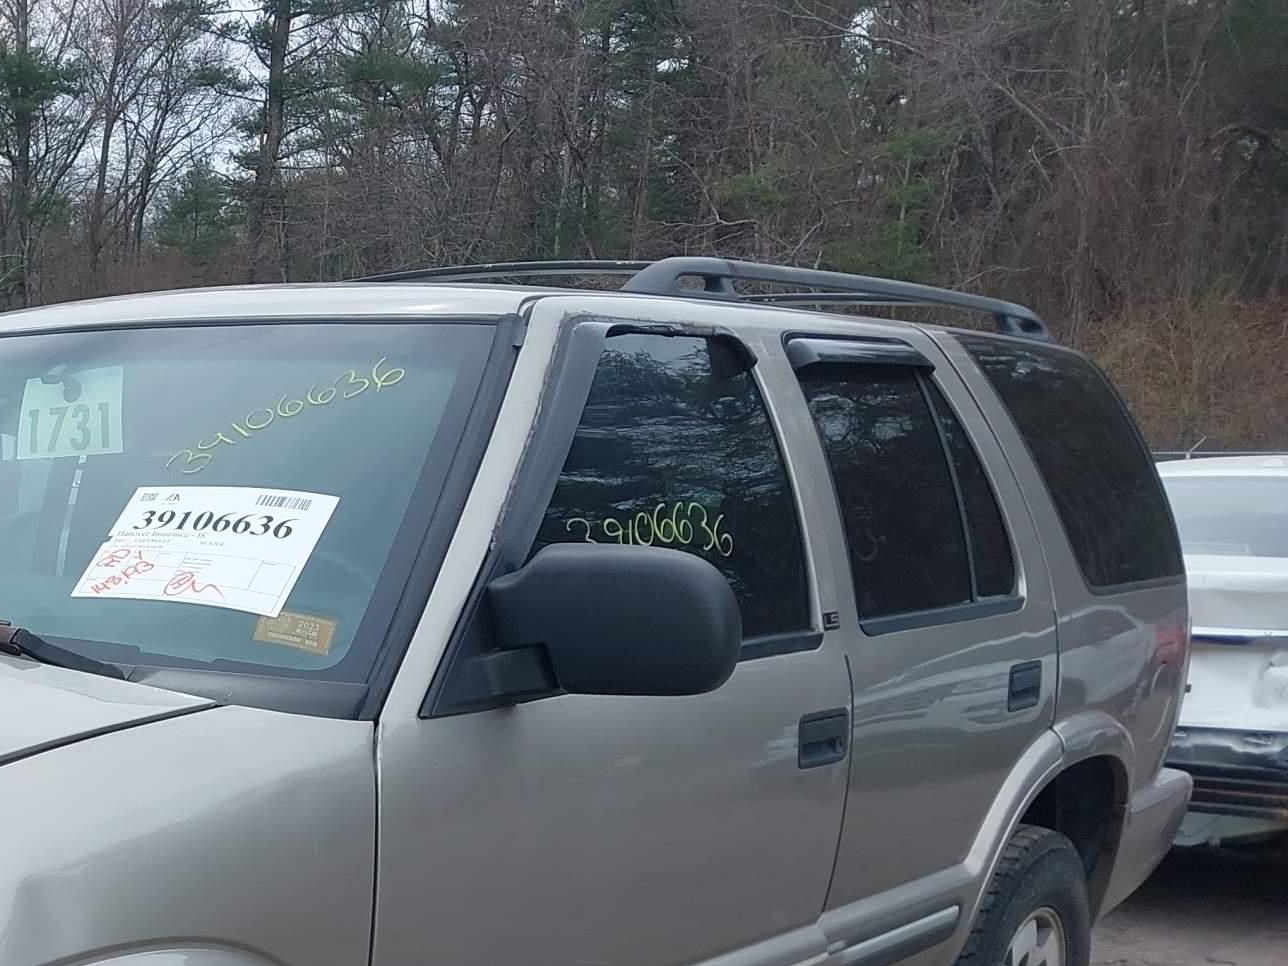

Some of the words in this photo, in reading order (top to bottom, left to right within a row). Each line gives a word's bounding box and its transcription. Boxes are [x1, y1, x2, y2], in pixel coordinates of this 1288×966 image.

[28, 402, 111, 454] 1731
[165, 357, 405, 474] 39106636
[132, 510, 297, 539] 39106636
[151, 530, 190, 539] Insurance
[566, 502, 734, 557] 39106636
